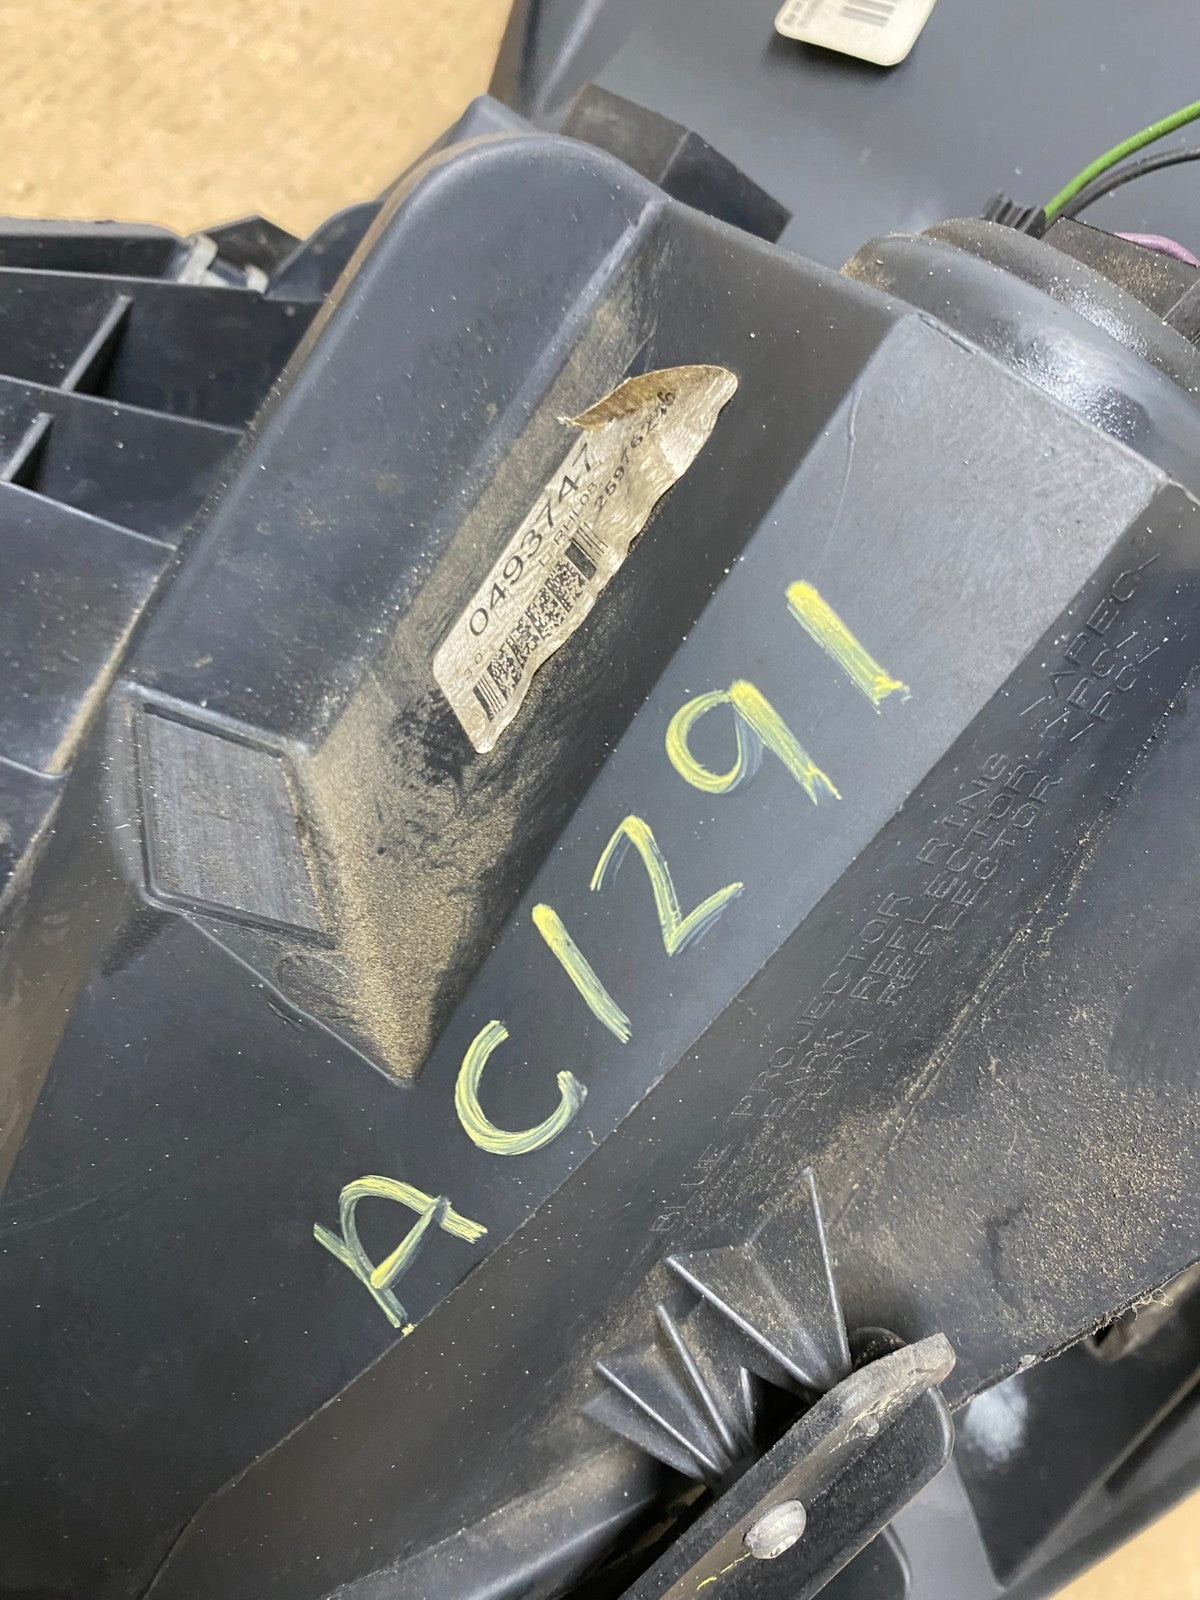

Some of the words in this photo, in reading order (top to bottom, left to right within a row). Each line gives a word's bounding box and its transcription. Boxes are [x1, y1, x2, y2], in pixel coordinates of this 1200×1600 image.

[467, 441, 590, 638] 0493747
[730, 890, 911, 1115] PROJECTOR
[916, 750, 1012, 865] RING
[848, 763, 1040, 1000] REFLECTOR
[876, 774, 1063, 1005] REFLECTOR
